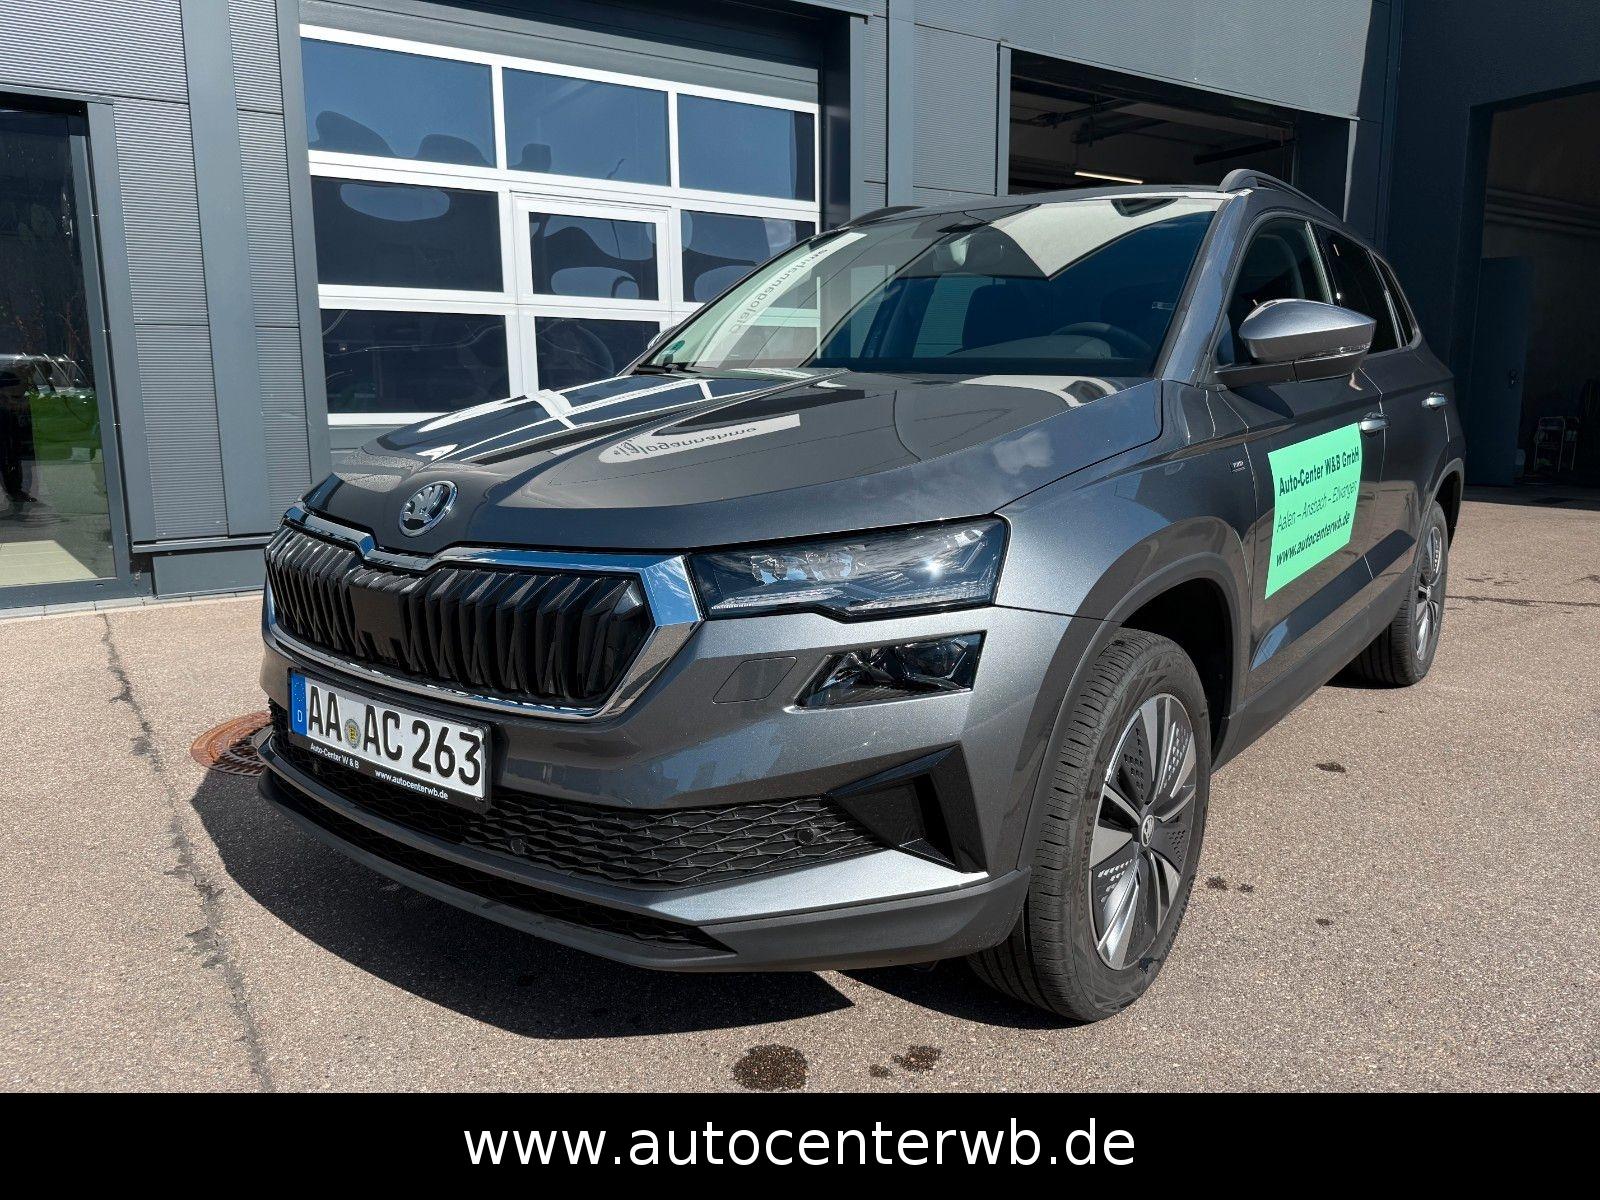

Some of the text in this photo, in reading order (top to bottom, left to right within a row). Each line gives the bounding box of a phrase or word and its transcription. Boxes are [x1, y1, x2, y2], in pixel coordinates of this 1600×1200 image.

[1279, 446, 1360, 496] Auto-Center W&B GmbH
[1276, 511, 1296, 533] Aalen
[1301, 496, 1328, 519] Ansbach
[1276, 512, 1350, 566] www.autocenterwb.de
[297, 710, 303, 723] D
[308, 685, 481, 786] AA AC 263
[310, 743, 360, 769] Auto-Center W & B
[374, 769, 449, 800] www.autocenterwb.de
